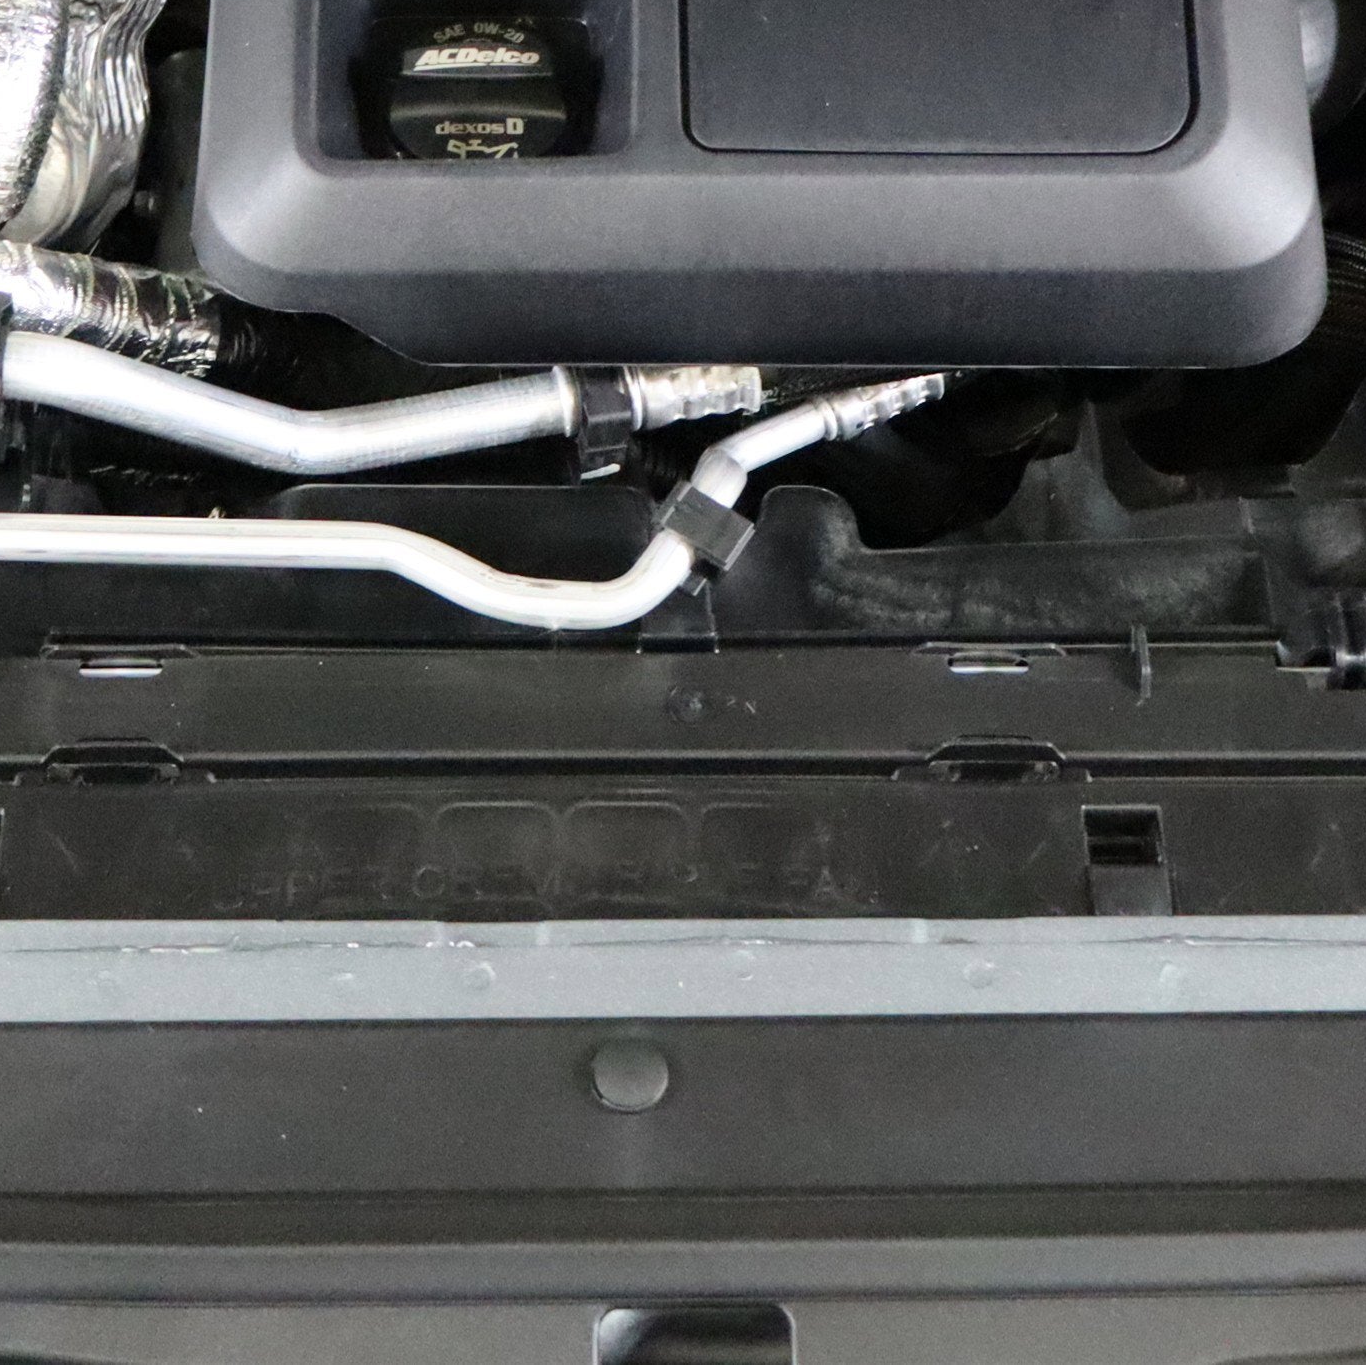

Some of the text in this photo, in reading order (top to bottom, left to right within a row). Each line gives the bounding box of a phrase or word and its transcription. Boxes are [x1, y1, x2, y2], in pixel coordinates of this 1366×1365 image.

[434, 21, 525, 44] SAE 0W-20
[414, 47, 541, 67] ACDelco
